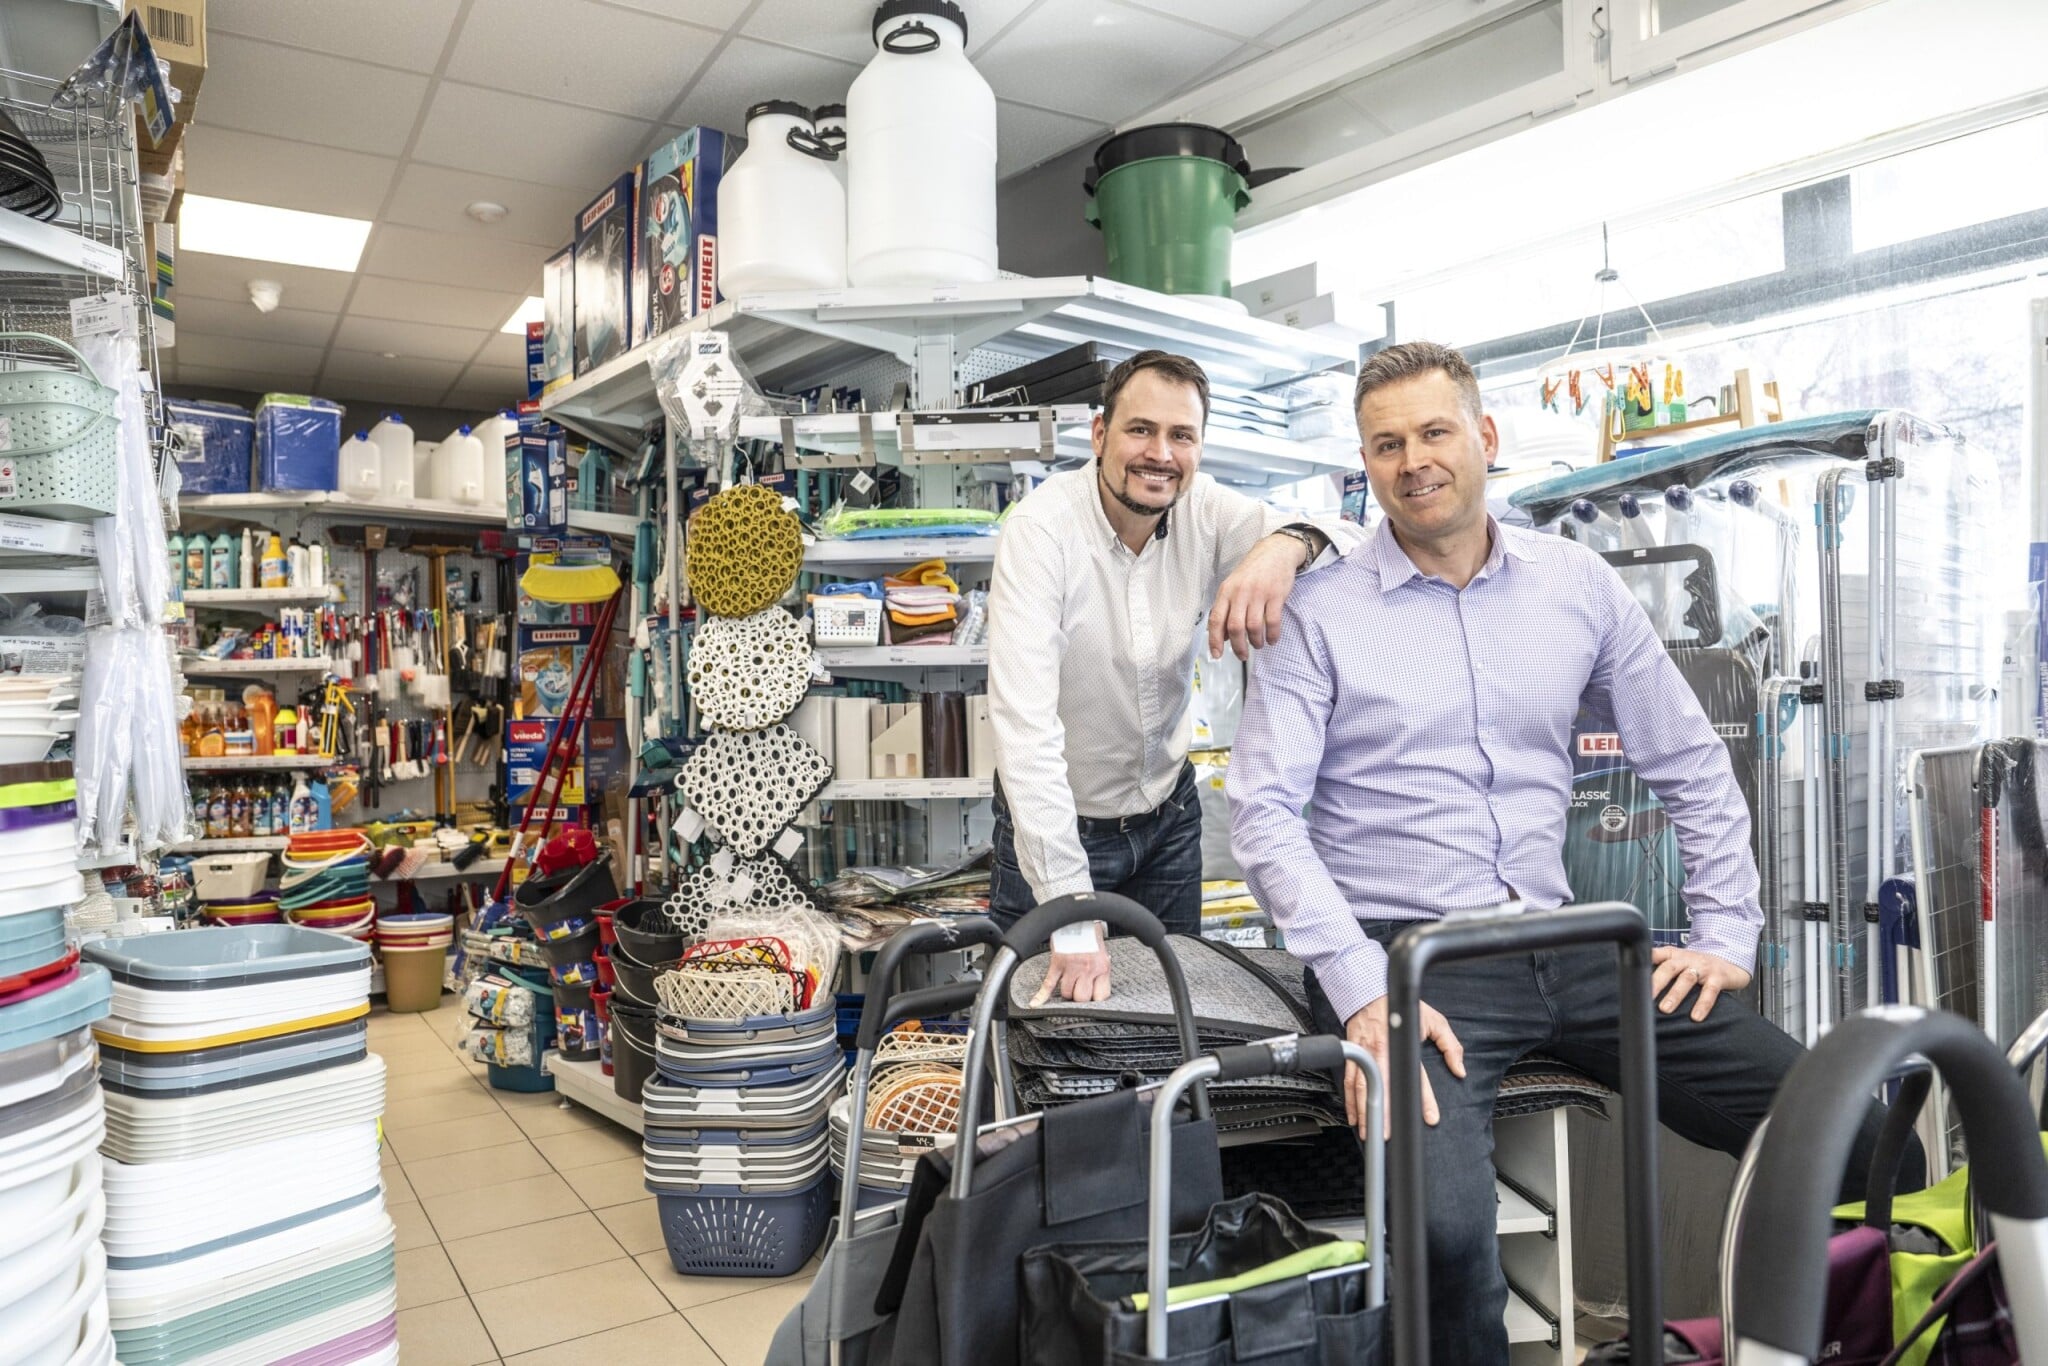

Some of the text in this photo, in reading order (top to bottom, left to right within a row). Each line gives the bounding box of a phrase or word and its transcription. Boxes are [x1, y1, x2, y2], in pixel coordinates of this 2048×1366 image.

[583, 193, 614, 227] LEIFHEIT
[701, 239, 714, 310] EIFHEIT
[534, 631, 577, 639] LEIFHEIT
[513, 729, 543, 740] vileda
[1713, 725, 1746, 735] HEIT
